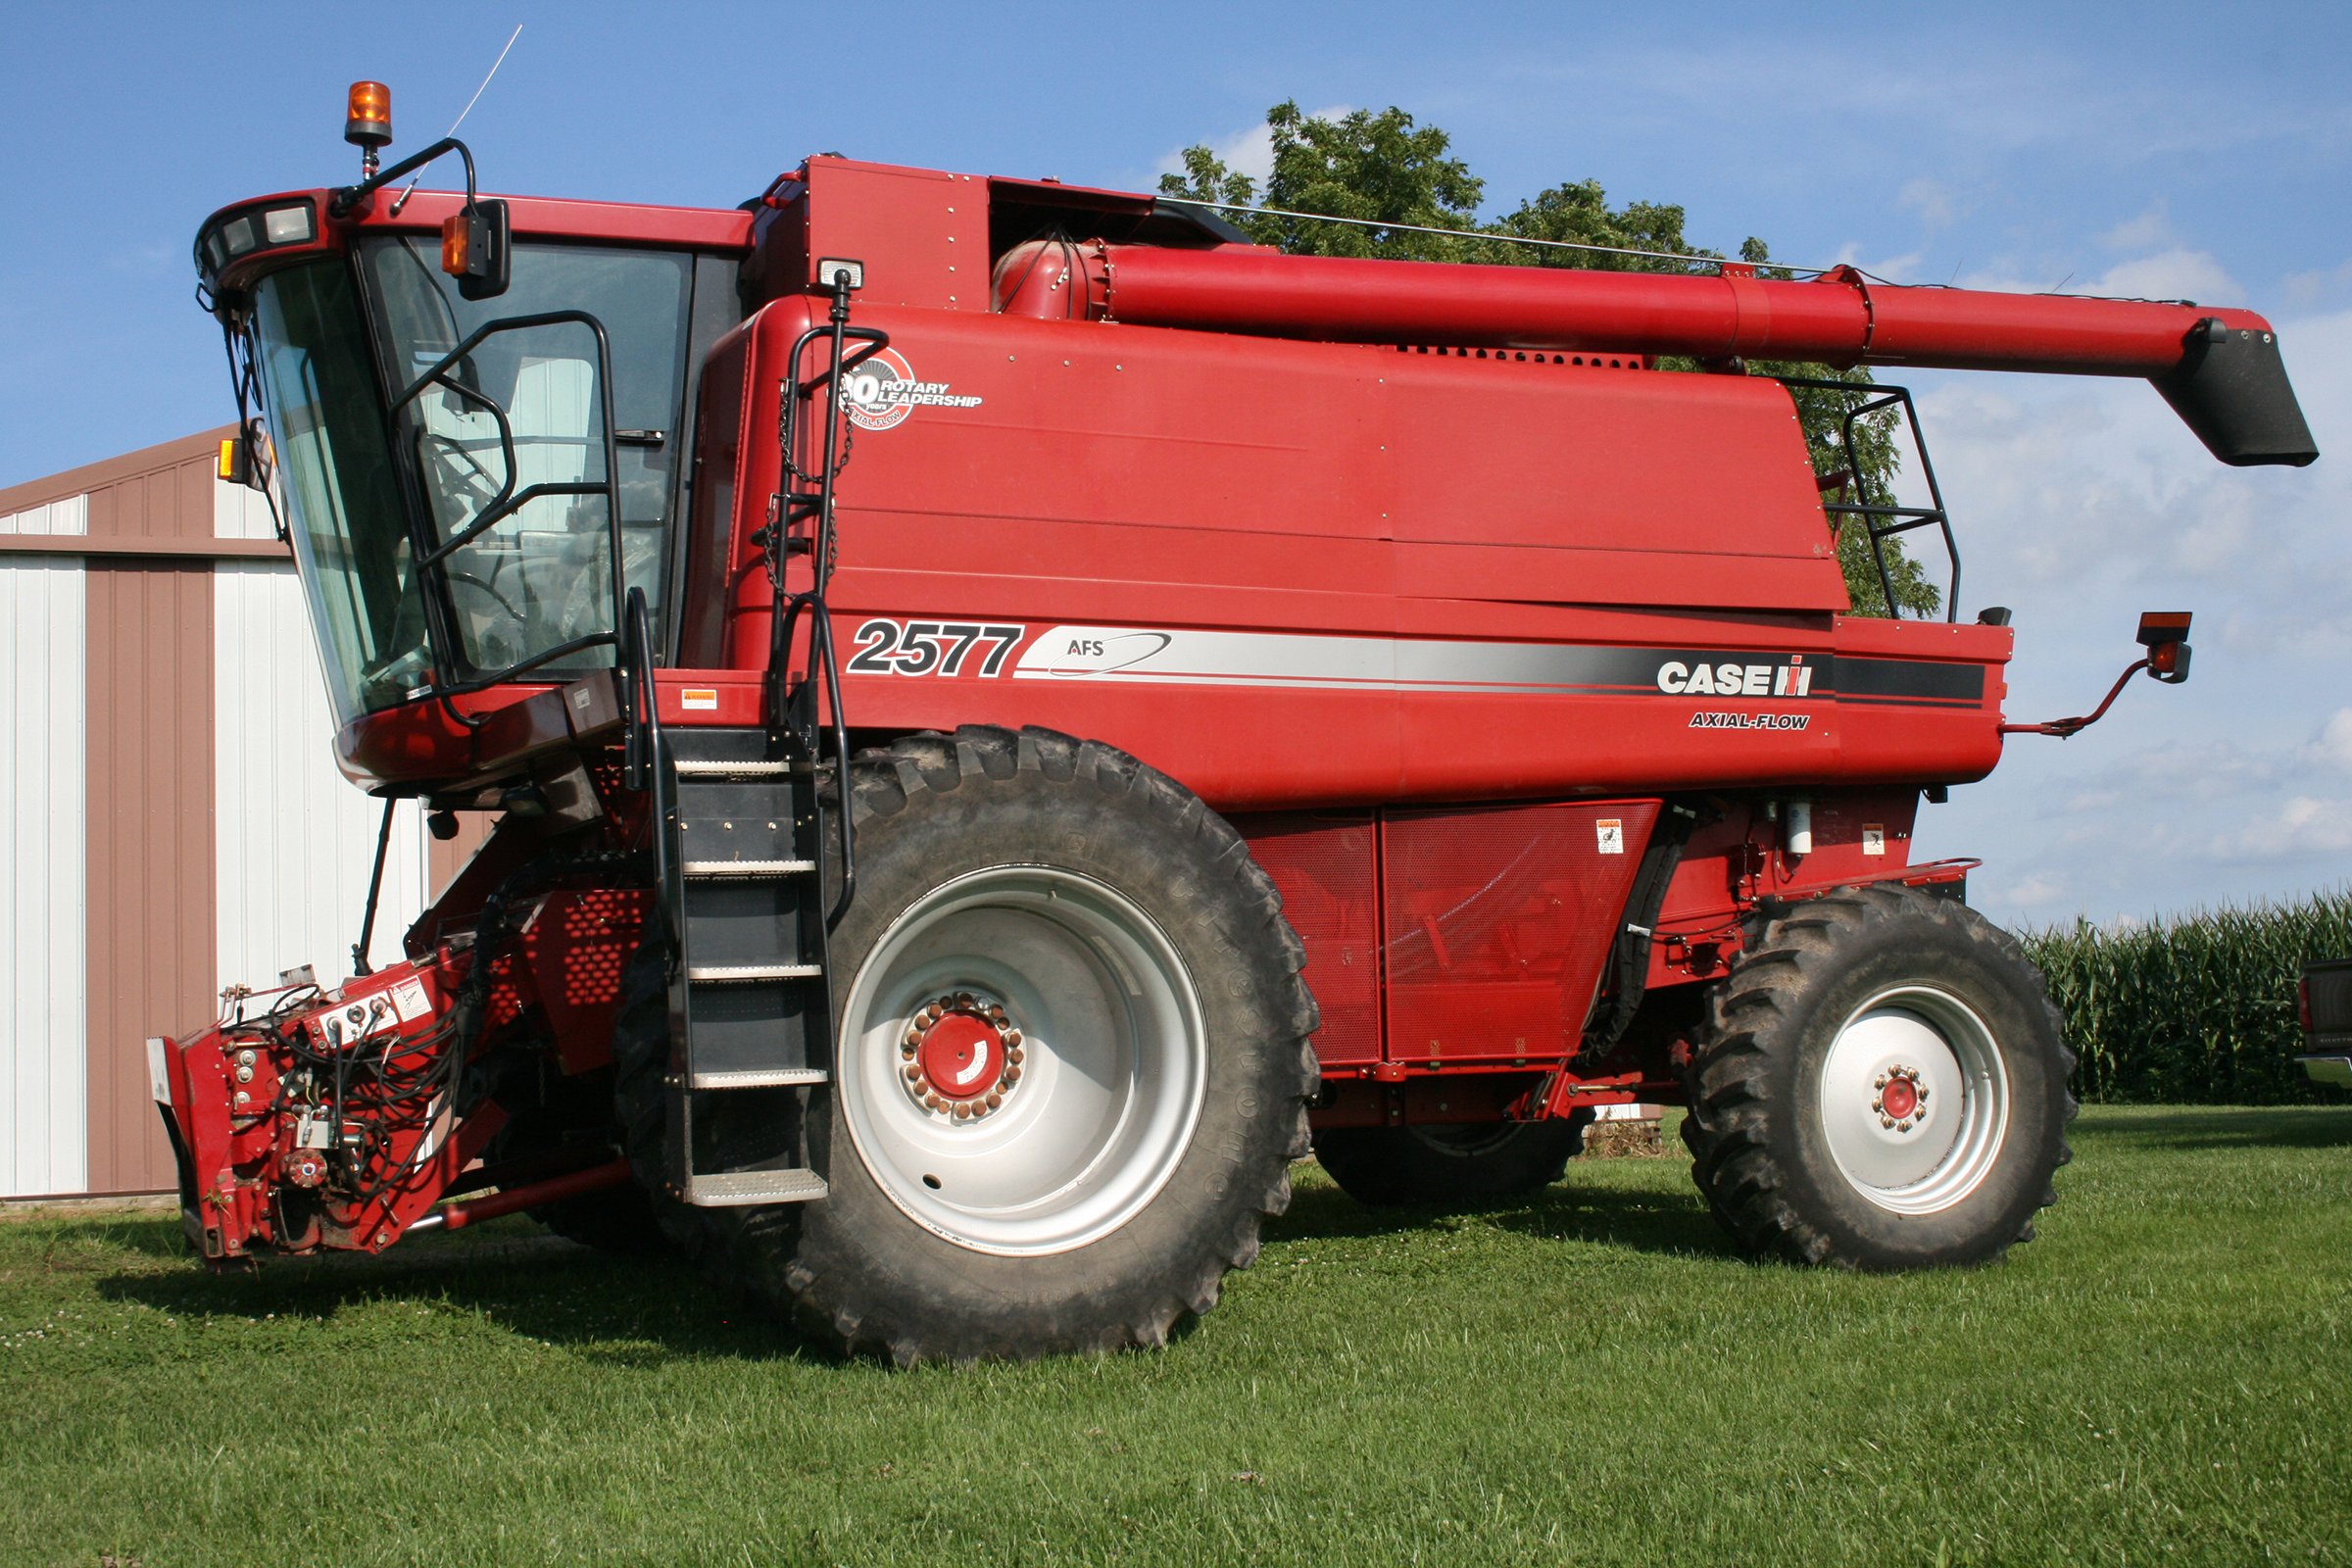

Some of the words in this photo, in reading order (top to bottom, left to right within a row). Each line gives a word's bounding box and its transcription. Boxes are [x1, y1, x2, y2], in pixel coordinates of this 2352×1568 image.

[880, 380, 949, 394] ROTARY
[880, 392, 982, 408] LEADERSHIP
[847, 618, 1025, 678] 2577
[1067, 640, 1104, 657] AFS
[1657, 662, 1772, 695] CASE
[1690, 712, 1810, 730] AXIAL-FLOW
